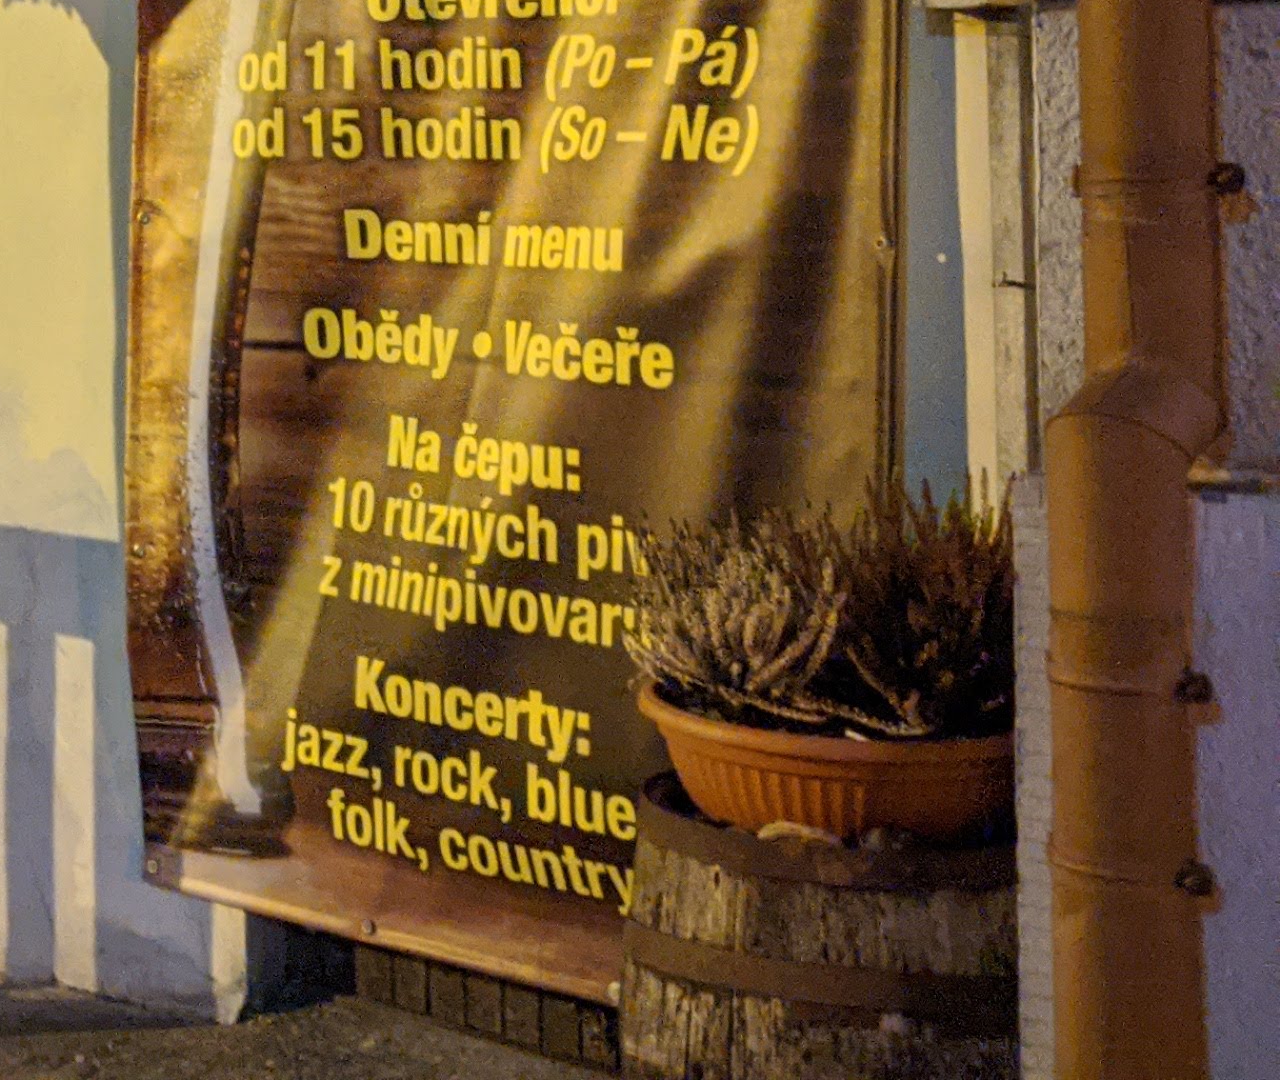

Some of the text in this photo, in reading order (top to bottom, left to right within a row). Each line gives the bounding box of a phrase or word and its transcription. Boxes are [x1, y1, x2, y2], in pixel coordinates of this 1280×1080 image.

[237, 40, 287, 92] od
[305, 42, 357, 90] 11
[380, 39, 522, 91] hodin
[545, 34, 616, 102] (Po
[664, 25, 760, 100] Pá)
[232, 110, 285, 160] od
[302, 110, 363, 160] 15
[380, 109, 522, 160] hodin
[539, 105, 604, 173] (So
[660, 104, 760, 177] Ne)
[344, 208, 624, 272] Denní menu
[303, 306, 674, 389] Obědy Večeře
[386, 414, 581, 497] Na čepu:
[328, 477, 375, 532] 10
[383, 483, 559, 565] různých
[318, 555, 340, 598] z
[355, 656, 591, 762] Koncerty:
[281, 712, 637, 841] jazz, rock, blue
[327, 787, 635, 916] folk, country
